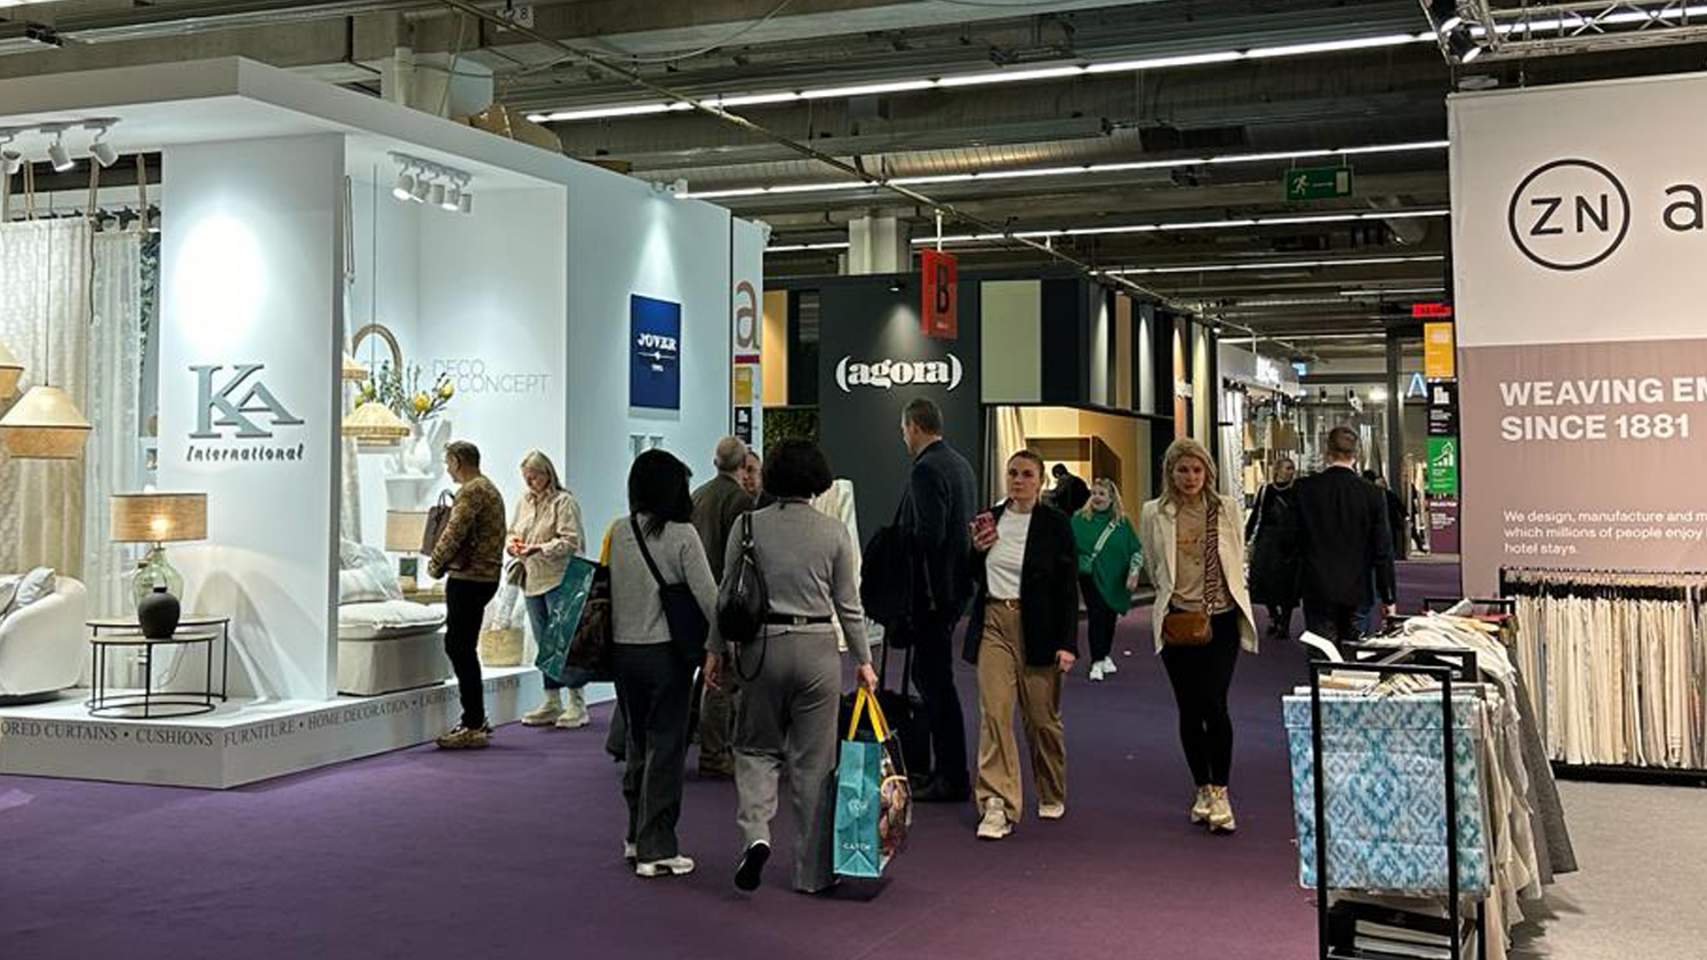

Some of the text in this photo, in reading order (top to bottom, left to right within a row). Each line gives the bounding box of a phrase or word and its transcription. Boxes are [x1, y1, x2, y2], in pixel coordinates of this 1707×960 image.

[1530, 194, 1609, 236] ZN
[1662, 184, 1704, 232] a
[936, 263, 950, 314] B
[736, 281, 760, 350] a
[637, 332, 677, 351] JOVER
[433, 359, 485, 378] DECO
[835, 353, 963, 392] (agora)
[457, 374, 552, 393] CONCEPT
[1499, 378, 1664, 406] WEAVING
[188, 364, 305, 438] KA
[1501, 413, 1689, 441] SINCE 1881
[187, 443, 304, 461] International
[1504, 511, 1523, 522] We
[1527, 510, 1577, 524] design,
[1578, 511, 1664, 522] manufacture
[1667, 511, 1693, 522] and
[1504, 526, 1703, 540] which millions of people enjoy
[1505, 542, 1538, 553] hotel
[44, 724, 118, 741] CURTAINS
[136, 730, 214, 747] CUSHIONS
[223, 715, 297, 748] FURNITURE
[308, 708, 340, 731] HOME
[343, 700, 410, 724] DECORATION
